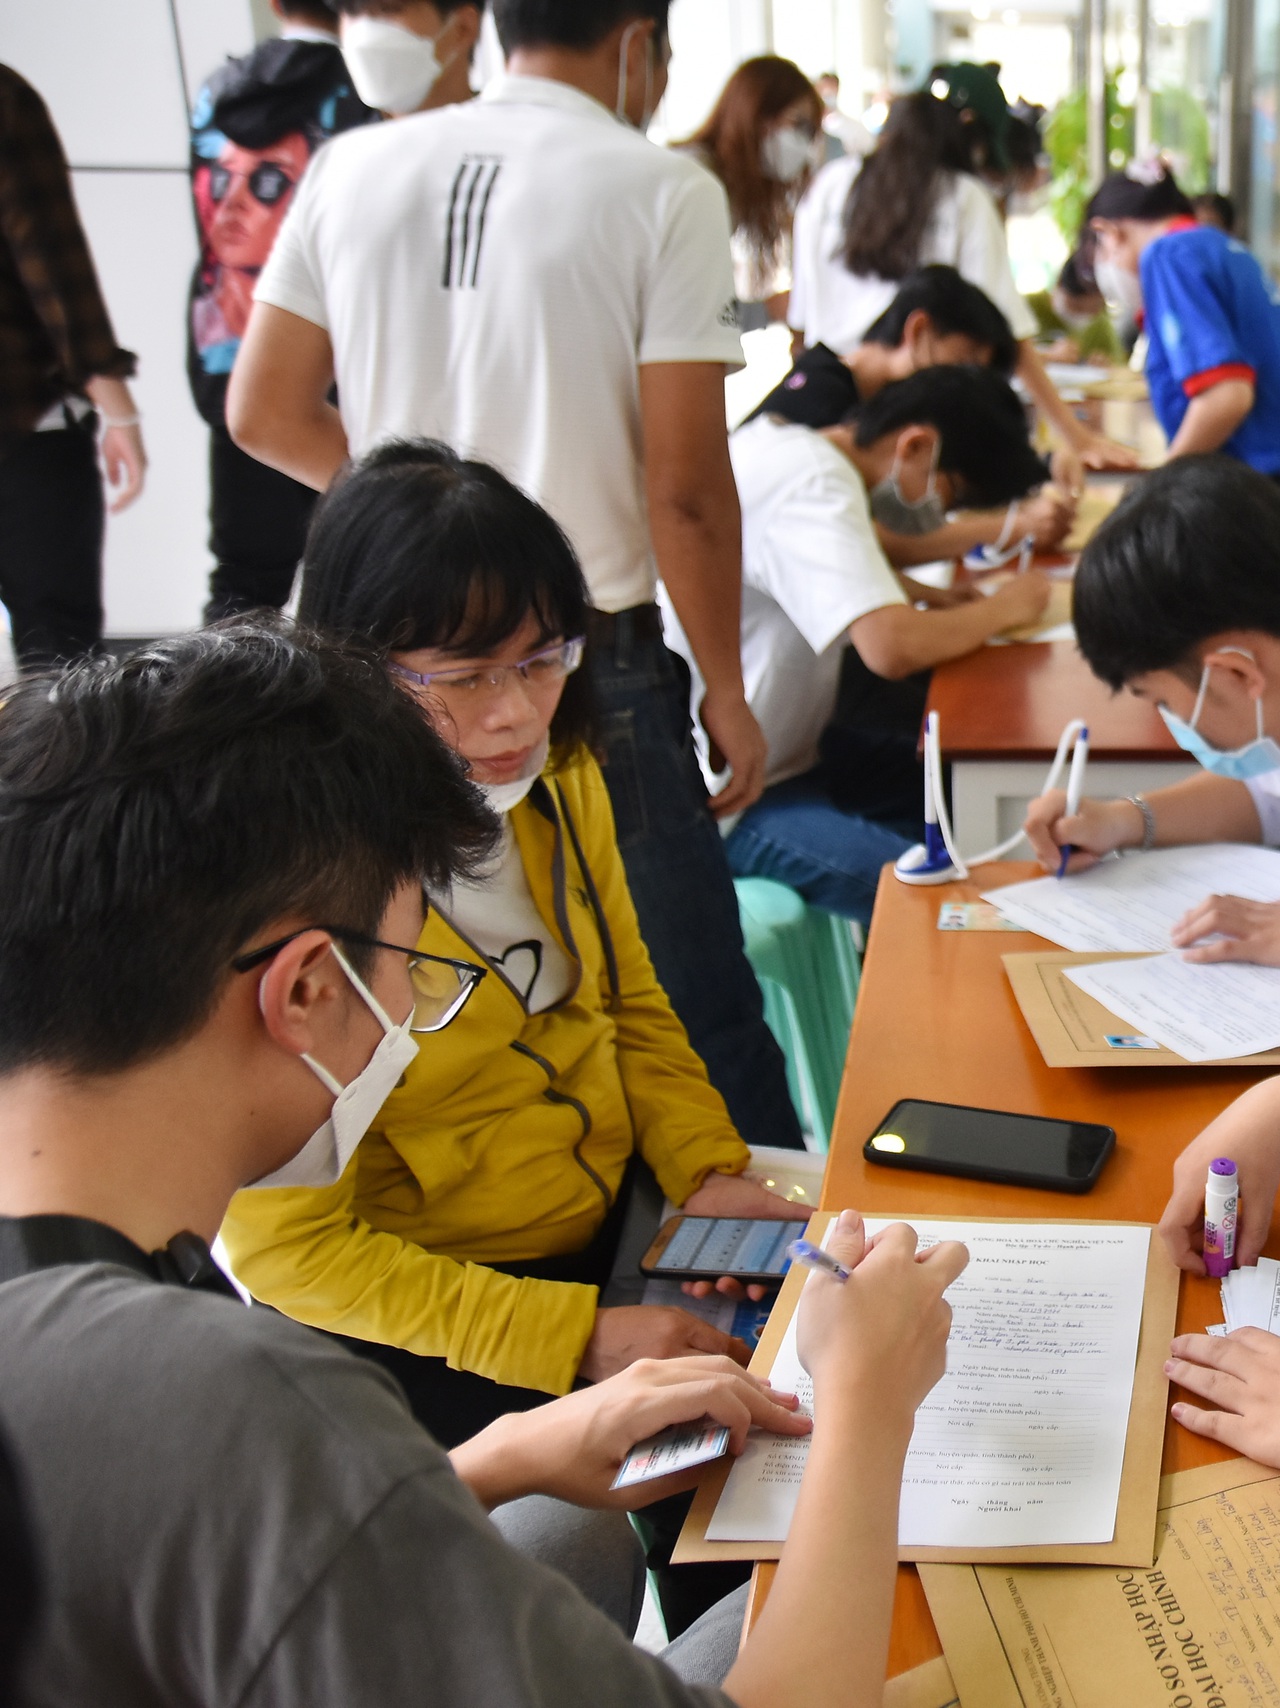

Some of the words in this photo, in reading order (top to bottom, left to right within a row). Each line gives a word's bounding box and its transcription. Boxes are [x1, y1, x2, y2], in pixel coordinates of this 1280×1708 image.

[951, 1498, 970, 1506] Ngày
[986, 1499, 1009, 1507] tháng
[1026, 1498, 1044, 1506] năm
[977, 1505, 1003, 1513] Người
[1114, 1568, 1151, 1609] HỌC
[1140, 1568, 1187, 1628] CHÍNH
[1130, 1607, 1176, 1662] NHẬP
[1172, 1625, 1213, 1672] HỌC
[1155, 1661, 1186, 1692] SƠ
[1193, 1671, 1231, 1708] ĐẠI
